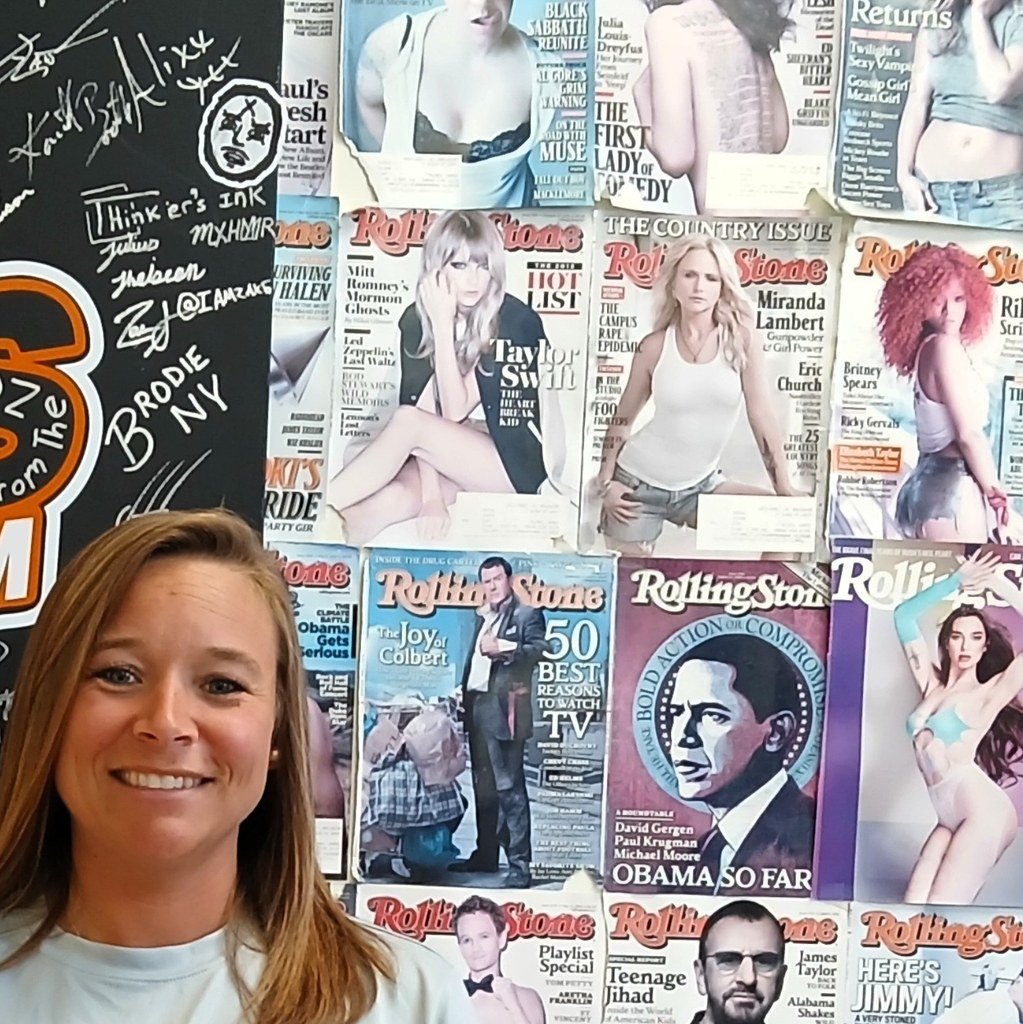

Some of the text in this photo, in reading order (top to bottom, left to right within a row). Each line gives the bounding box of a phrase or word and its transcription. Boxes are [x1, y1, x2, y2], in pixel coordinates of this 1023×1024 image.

[547, 3, 588, 19] BLACK
[850, 0, 953, 28] Returns
[527, 19, 587, 36] SABBATH
[598, 17, 624, 28] Julia
[539, 36, 587, 51] REUNITE
[597, 42, 643, 54] Dreyfus
[595, 101, 628, 123] THE
[595, 125, 651, 149] FIRST
[539, 143, 586, 162] MUSE
[595, 149, 654, 176] LADY OF
[603, 217, 833, 243] THE COUNTRY ISSUE
[347, 265, 375, 277] Mitt
[347, 278, 409, 294] Romney's
[527, 271, 582, 290] HOT
[347, 291, 403, 304] Mormon
[527, 291, 581, 309] LIST
[757, 290, 826, 311] Miranda
[345, 304, 390, 315] Ghosts
[756, 311, 824, 331] Lambert
[492, 338, 580, 370] Taylor
[500, 364, 578, 390] Swift
[799, 362, 823, 377] Eric
[843, 362, 882, 377] Britney
[777, 377, 822, 392] Church
[843, 375, 878, 391] Spears
[104, 345, 211, 473] BRODIE
[169, 373, 229, 435] NY
[805, 429, 820, 443] 25
[297, 622, 350, 635] Obama
[377, 626, 399, 639] The
[399, 620, 438, 651] Joy
[317, 634, 350, 647] Gets
[542, 619, 600, 660] 50
[379, 646, 449, 667] Colbert
[538, 662, 601, 684] BEST
[636, 668, 661, 723] BOLD
[656, 617, 725, 671] ACTION
[537, 684, 601, 697] REASONS
[538, 699, 601, 711] TO WATCH
[542, 712, 594, 739] TV
[614, 821, 694, 838] David Gergen
[614, 836, 698, 853] Paul Krugman
[614, 849, 701, 863] Michael Moore
[612, 863, 813, 892] OBAMA SO FAR
[539, 945, 594, 963] Playlist
[798, 950, 838, 965] James
[539, 959, 594, 976] Special
[796, 963, 837, 978] Taylor
[857, 958, 941, 984] HERE'S
[606, 966, 687, 993] Teenage
[605, 986, 654, 1007] Jihad
[787, 998, 836, 1009] Alabama
[850, 984, 953, 1015] JIMMY!
[797, 1008, 836, 1019] Shakes
[862, 1015, 883, 1023] VERY
[884, 1016, 916, 1024] STONED
